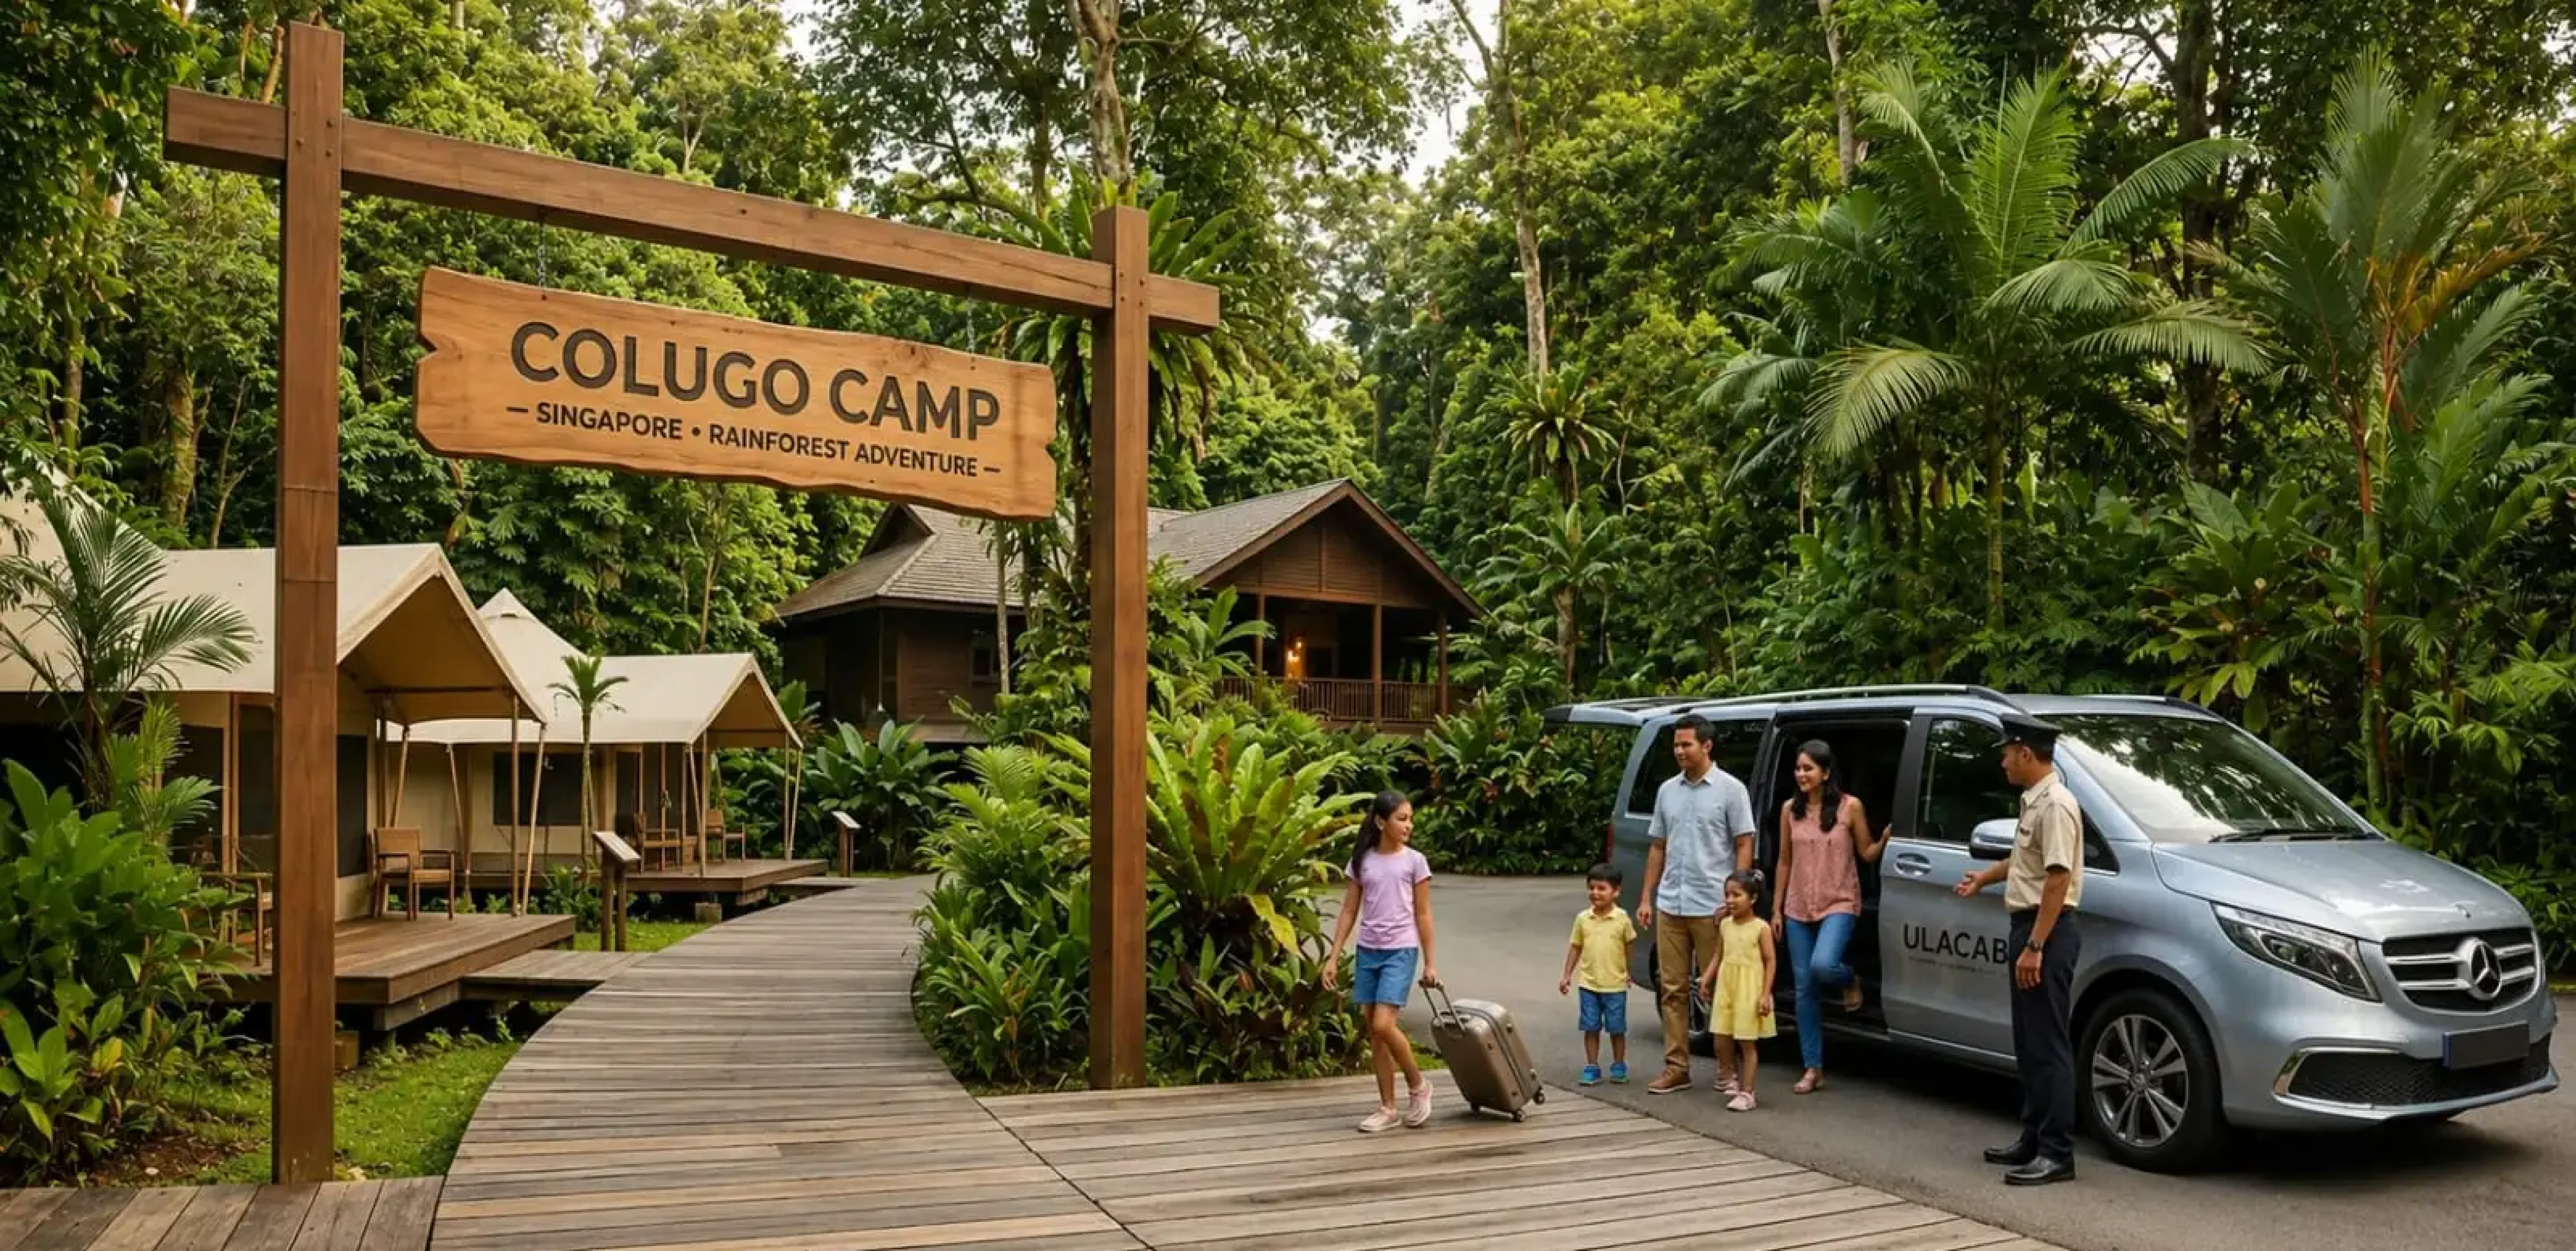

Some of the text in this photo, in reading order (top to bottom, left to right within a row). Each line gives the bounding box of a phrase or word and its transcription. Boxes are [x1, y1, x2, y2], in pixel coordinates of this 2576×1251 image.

[511, 322, 1000, 441] COLUGO CAMP
[536, 402, 978, 477] SINGAPORE RAINFOREST ADVENTURE
[1903, 923, 2008, 964] ULACAB
